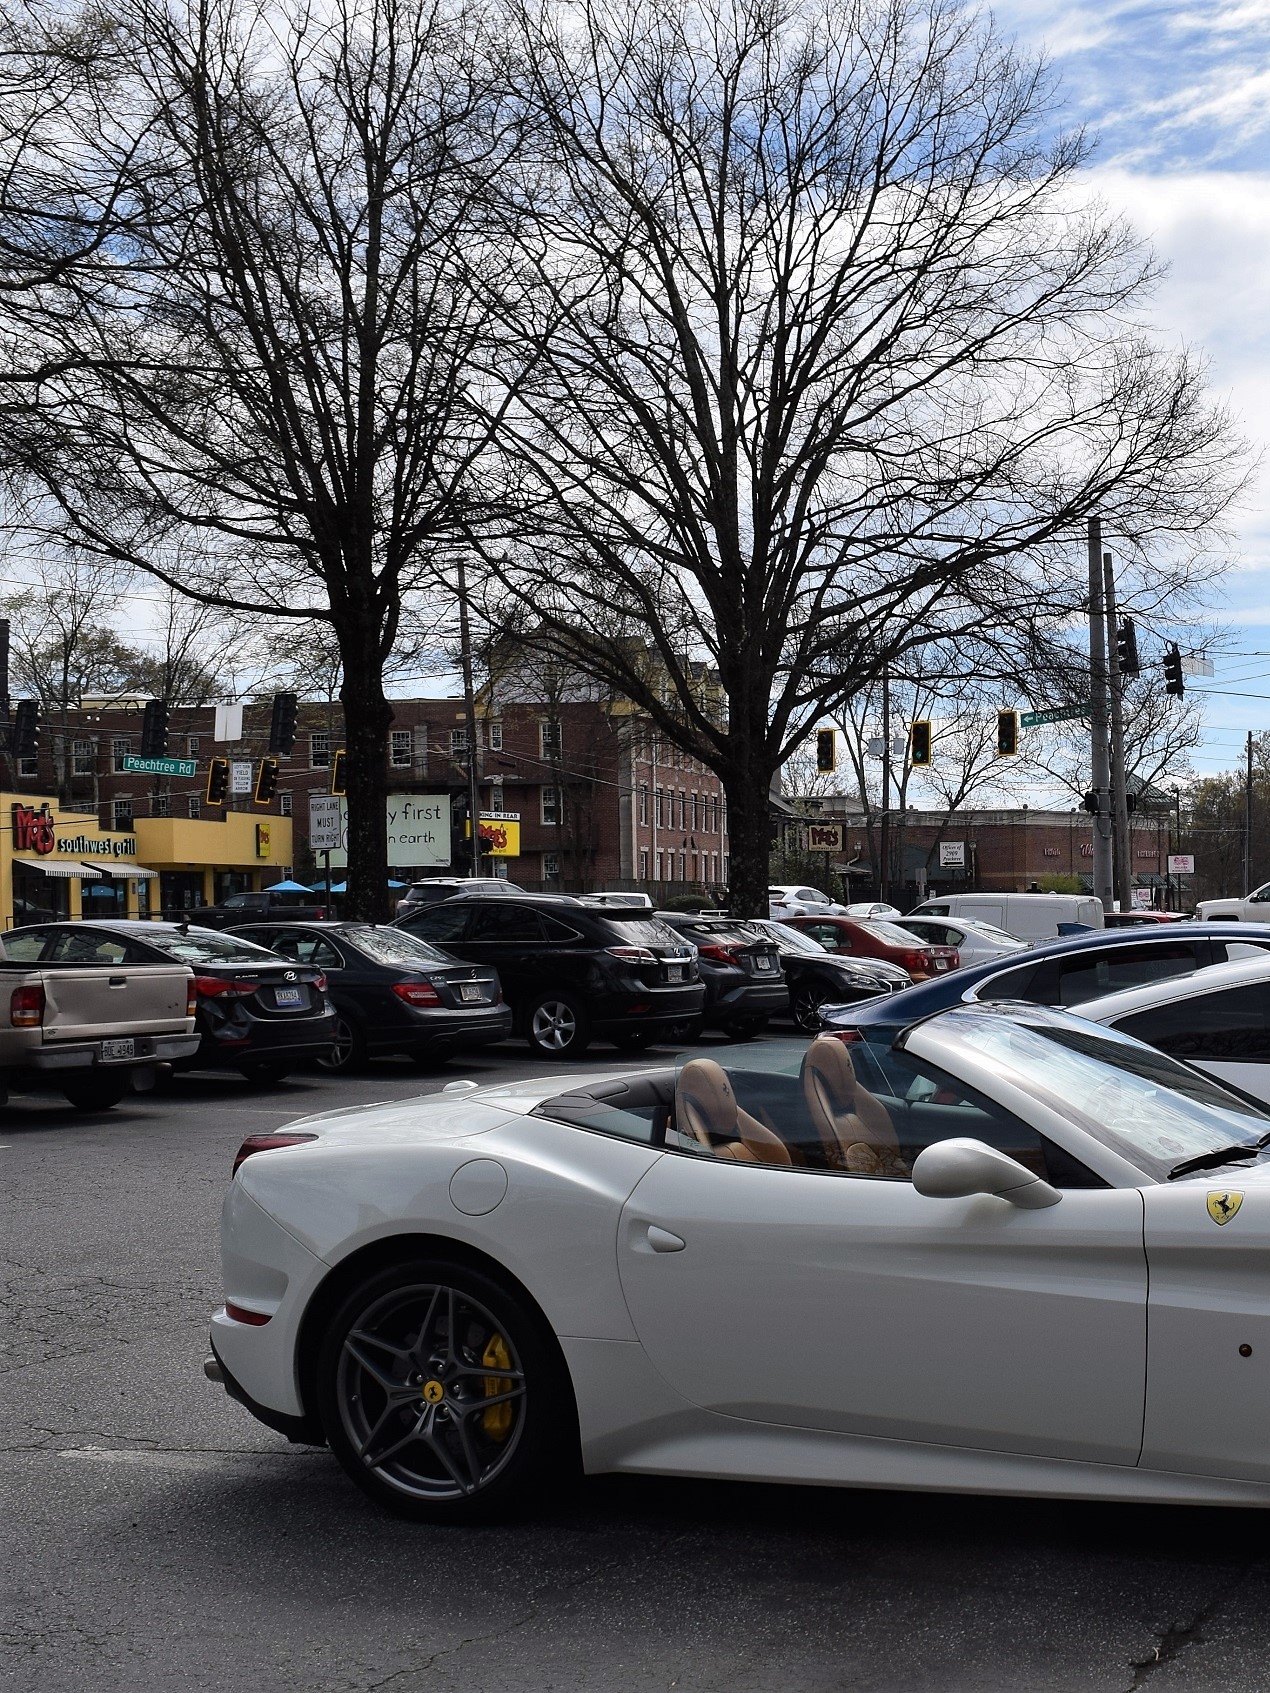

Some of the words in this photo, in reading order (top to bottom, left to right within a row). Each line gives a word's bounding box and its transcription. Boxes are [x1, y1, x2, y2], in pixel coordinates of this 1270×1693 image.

[127, 757, 176, 772] Peachtree
[179, 762, 193, 774] Rd
[311, 803, 326, 811] RIGHT
[327, 801, 339, 810] LANE
[402, 802, 442, 820] first
[317, 817, 334, 828] MUST
[312, 834, 325, 843] TURN
[326, 833, 340, 842] RIGHT
[399, 830, 436, 844] earth
[113, 838, 137, 857] grill
